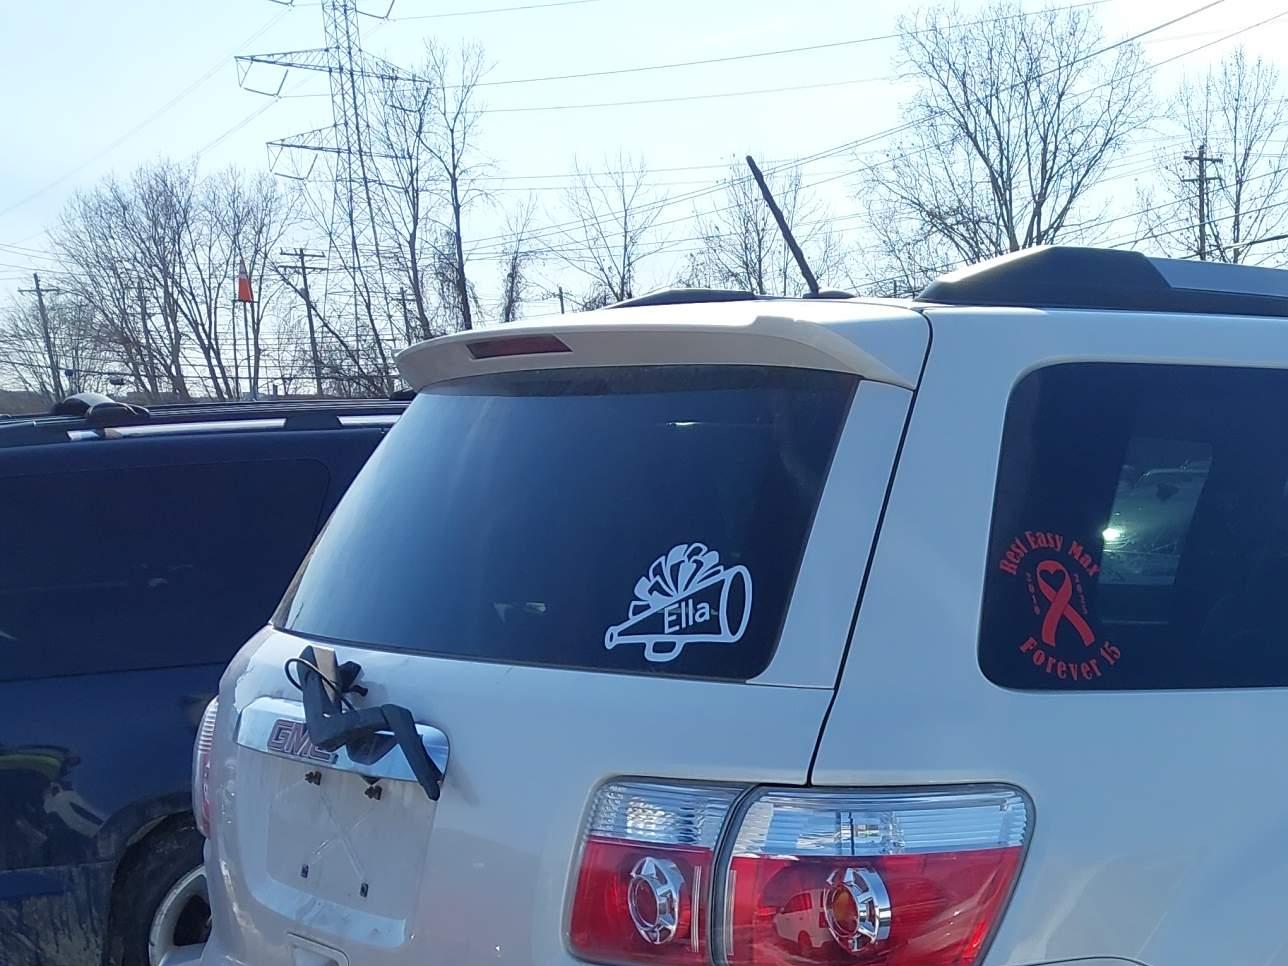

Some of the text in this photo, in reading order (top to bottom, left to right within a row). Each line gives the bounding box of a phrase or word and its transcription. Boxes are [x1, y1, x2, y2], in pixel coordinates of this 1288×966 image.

[999, 530, 1101, 577] Rest Easy Max
[663, 598, 711, 634] Ella
[1018, 636, 1121, 681] Forever 15
